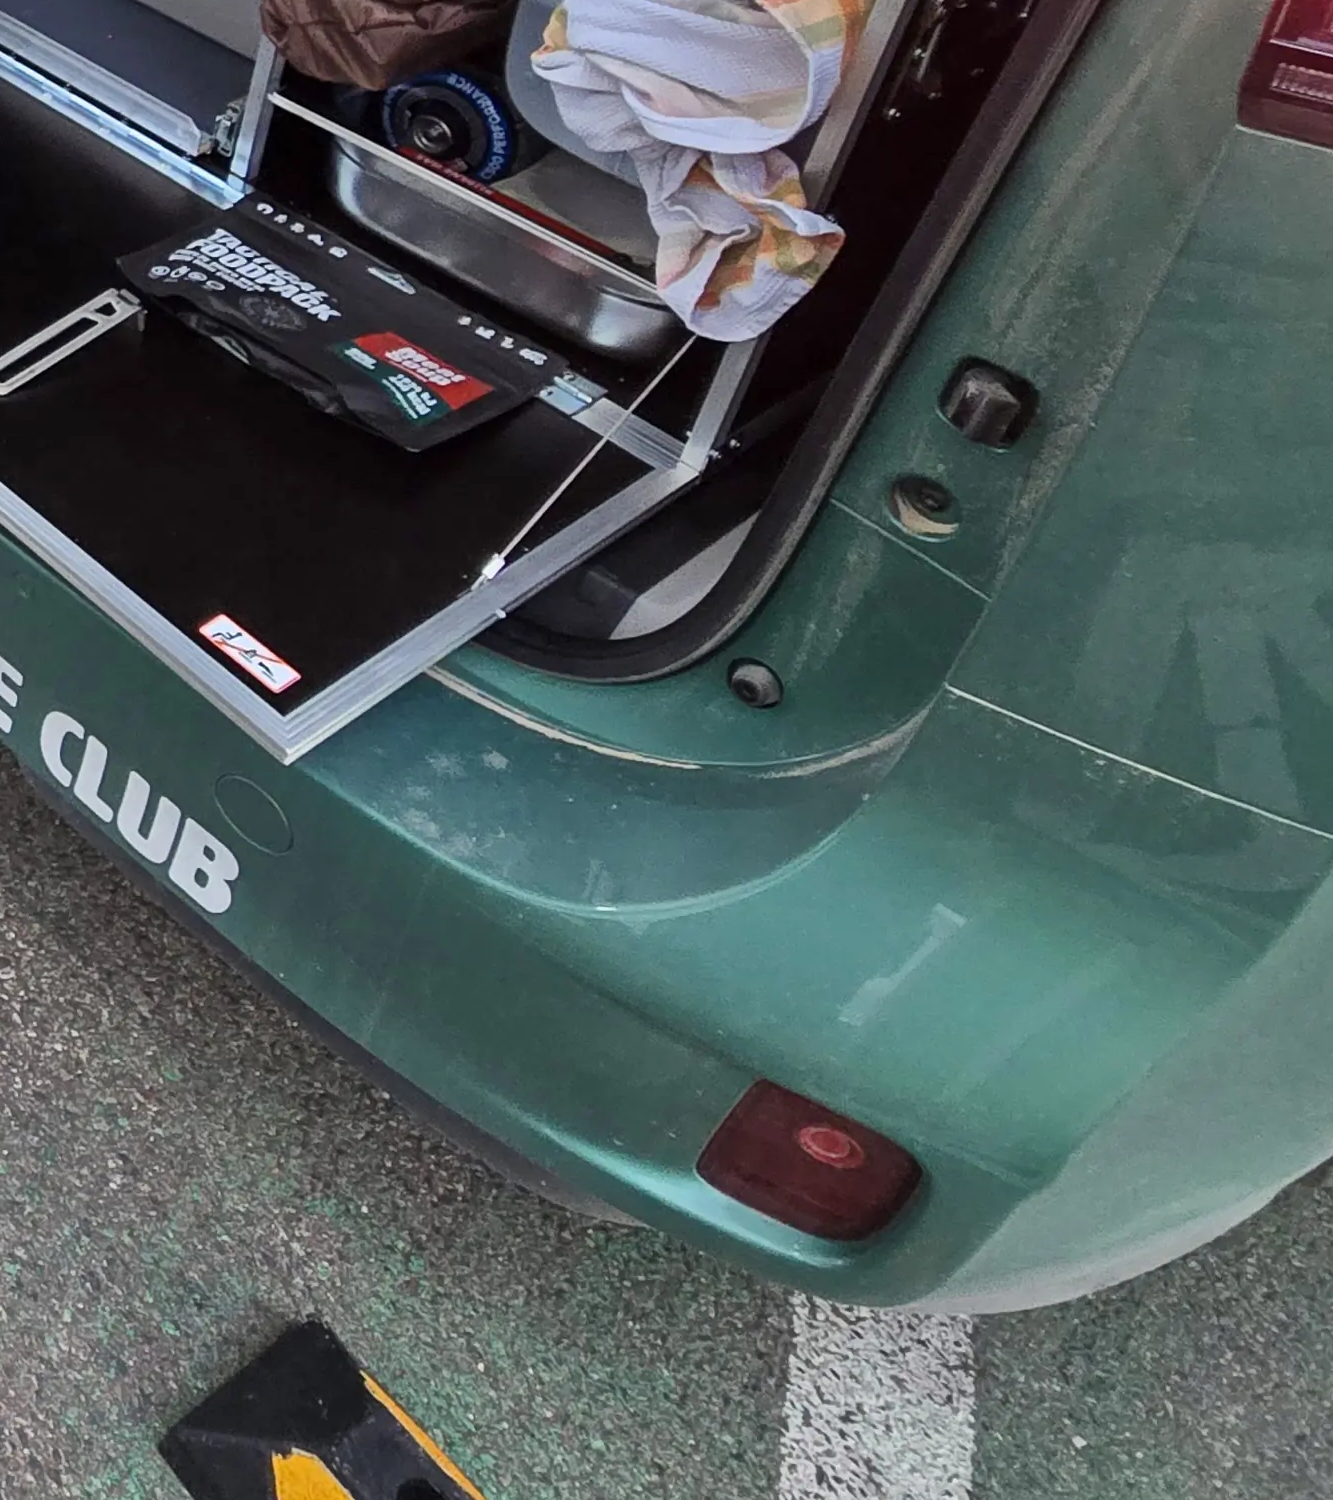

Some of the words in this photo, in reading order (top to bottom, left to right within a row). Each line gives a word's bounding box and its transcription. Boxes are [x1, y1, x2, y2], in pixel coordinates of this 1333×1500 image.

[446, 72, 508, 155] PERFORMANCE
[186, 238, 342, 323] FOODPACK
[208, 228, 330, 302] TACTICAL
[39, 710, 242, 915] CLUB
